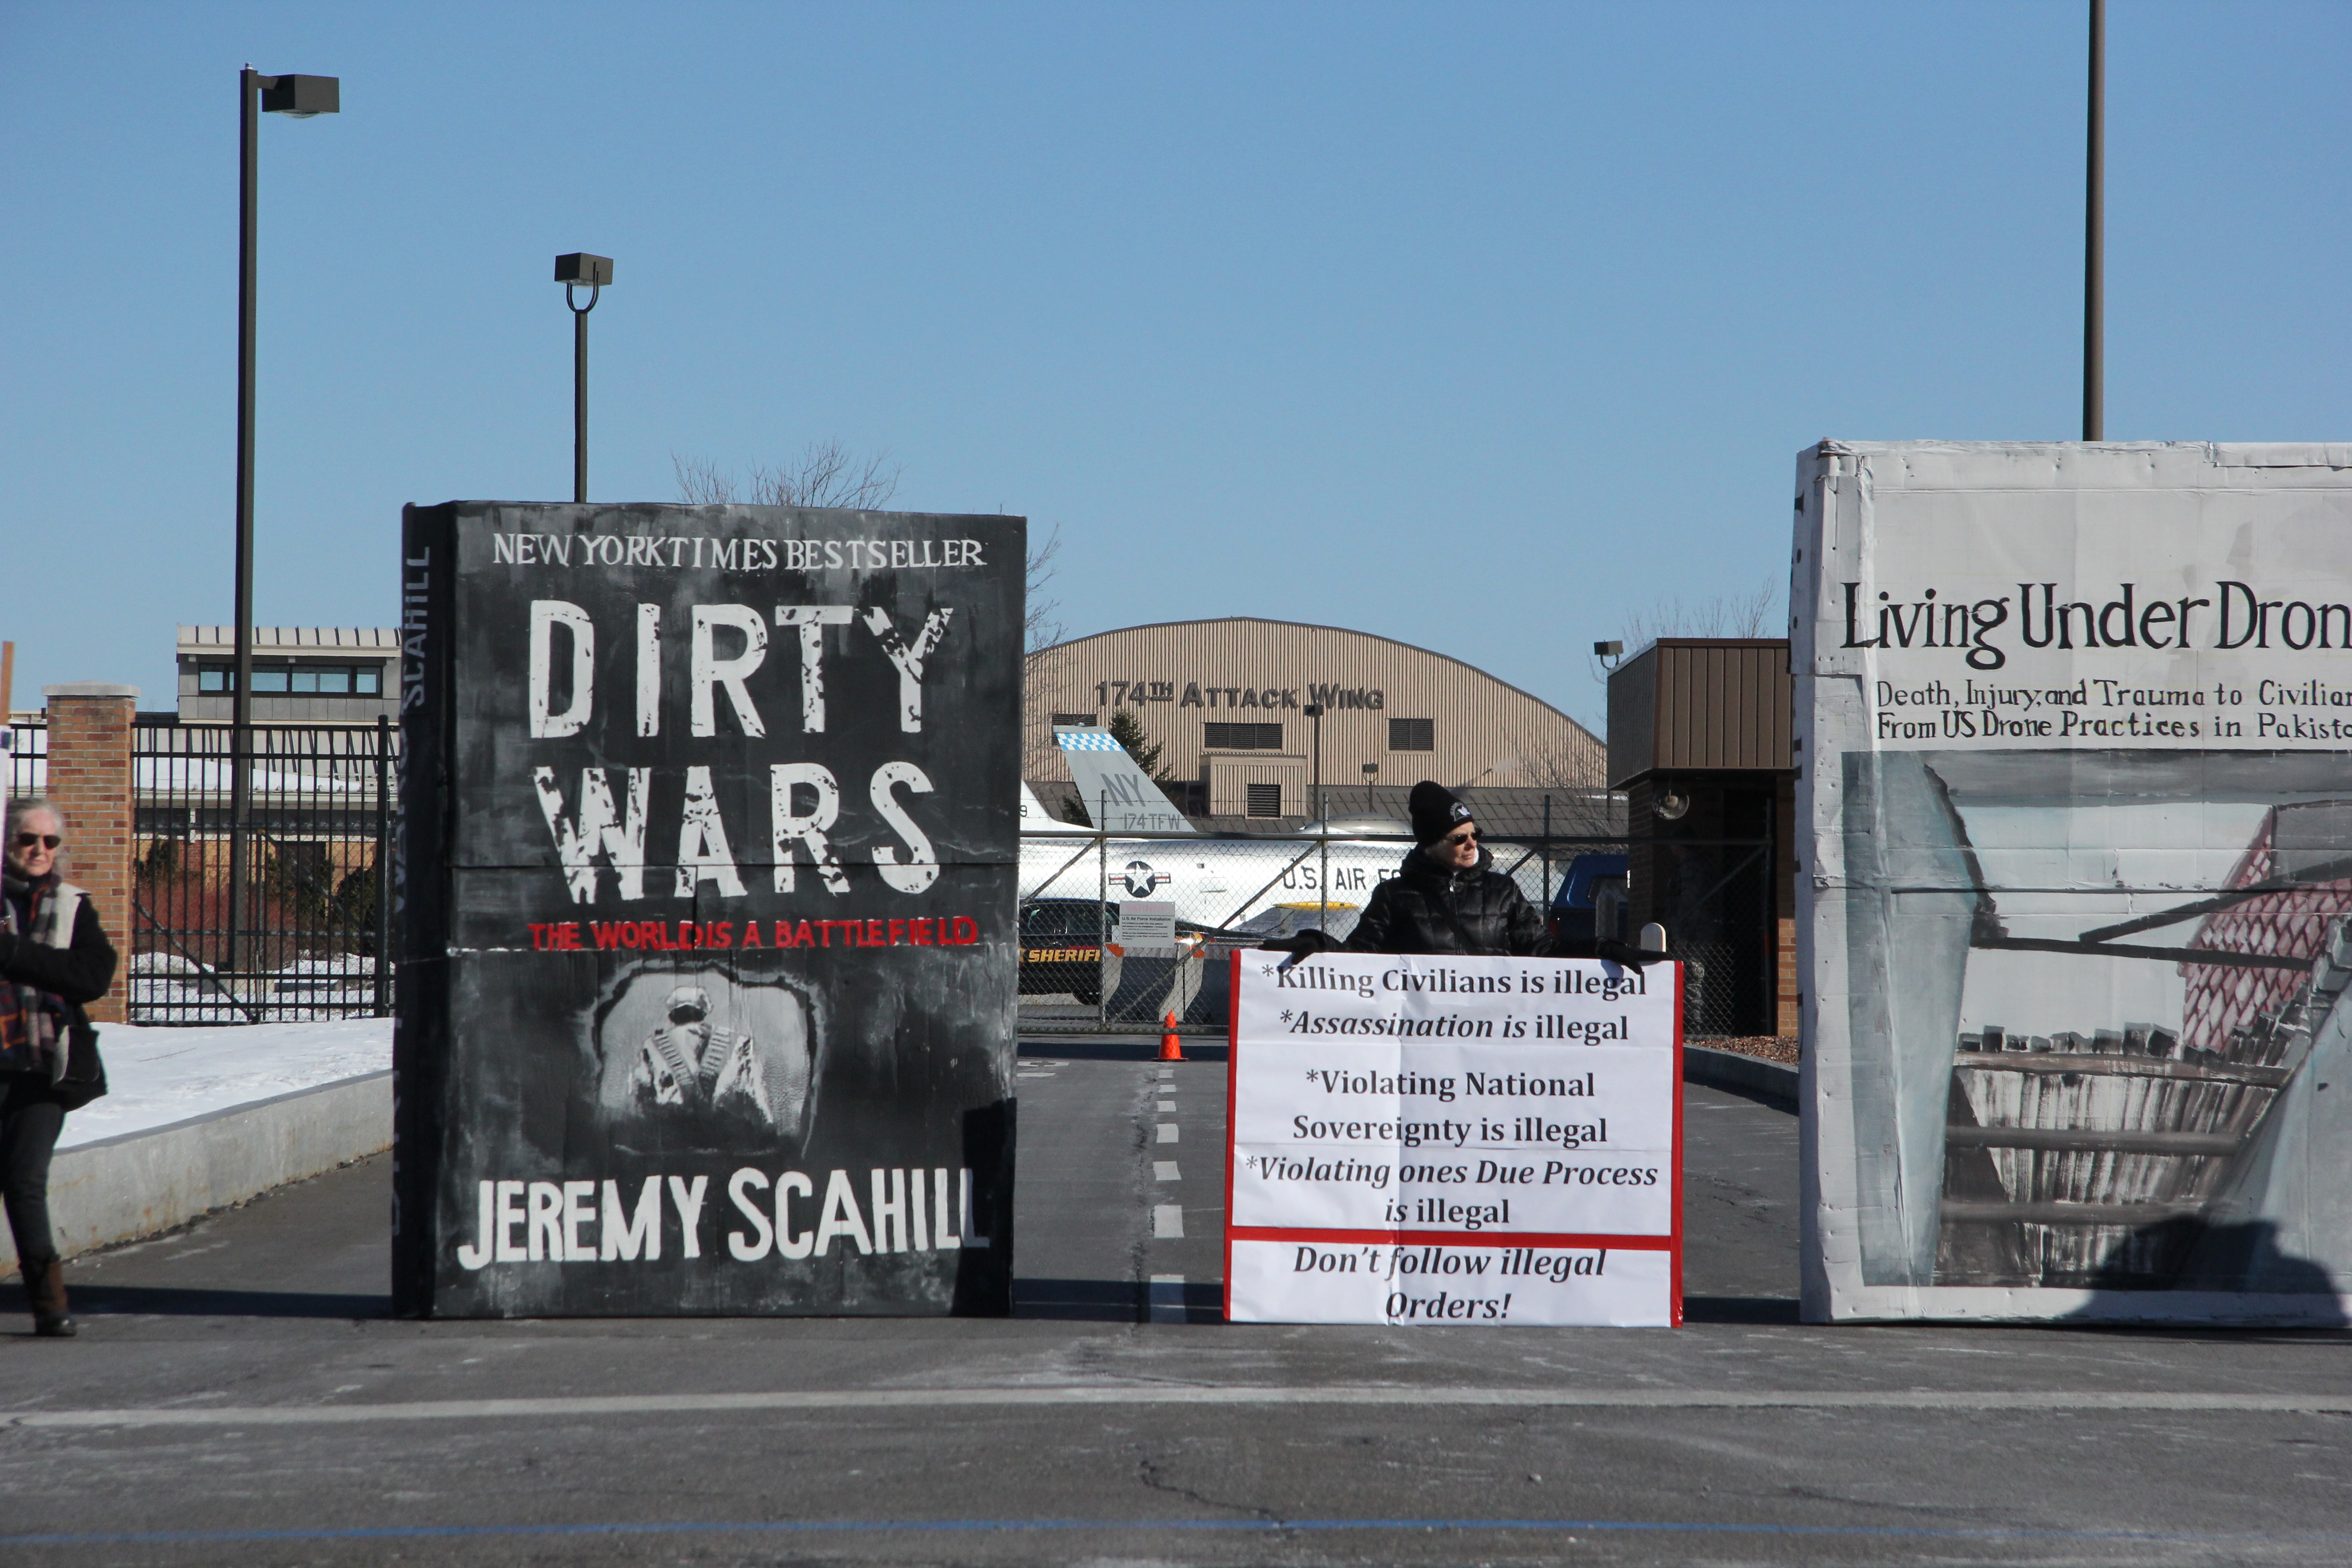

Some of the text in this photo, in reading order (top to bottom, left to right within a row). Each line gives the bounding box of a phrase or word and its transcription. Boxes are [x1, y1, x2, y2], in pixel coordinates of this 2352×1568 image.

[493, 533, 987, 572] NEW YORK TIMES BESTSELLER
[403, 546, 430, 710] SCAHILL
[1841, 582, 2009, 670] Living
[2017, 582, 2210, 649] Under
[529, 599, 954, 739] DIRTY
[1096, 681, 1385, 710] 174TH ATTACK WING
[1877, 680, 1960, 709] Death,
[2045, 678, 2087, 706] and
[2093, 681, 2203, 707] Trauma
[2212, 682, 2243, 706] to
[1877, 710, 1936, 740] From
[1941, 709, 1977, 739] US
[1981, 710, 2053, 737] Drone
[2060, 710, 2200, 739] Practices
[2214, 716, 2243, 737] in
[1100, 774, 1146, 807] NY
[533, 761, 941, 904] WARS
[1335, 867, 1367, 890] AIR
[527, 916, 979, 951] THE WORLD IS A BATTLEFIELD
[1382, 968, 1511, 995] Civilians
[1520, 970, 1545, 995] is
[1554, 969, 1646, 1002] illegal
[1502, 1014, 1527, 1039] is
[1535, 1014, 1628, 1046] illegal
[1465, 1071, 1595, 1098] National
[1293, 1114, 1607, 1149] Sovereignty is illegal
[1398, 1162, 1467, 1185] ones
[1475, 1160, 1535, 1185] Due
[1542, 1161, 1658, 1186] Process
[457, 1166, 989, 1271] JEREMY SCAHILL
[1384, 1198, 1510, 1230] is illegal
[1294, 1246, 1606, 1283] Don't follow illegal
[1386, 1291, 1512, 1320] Orders!
